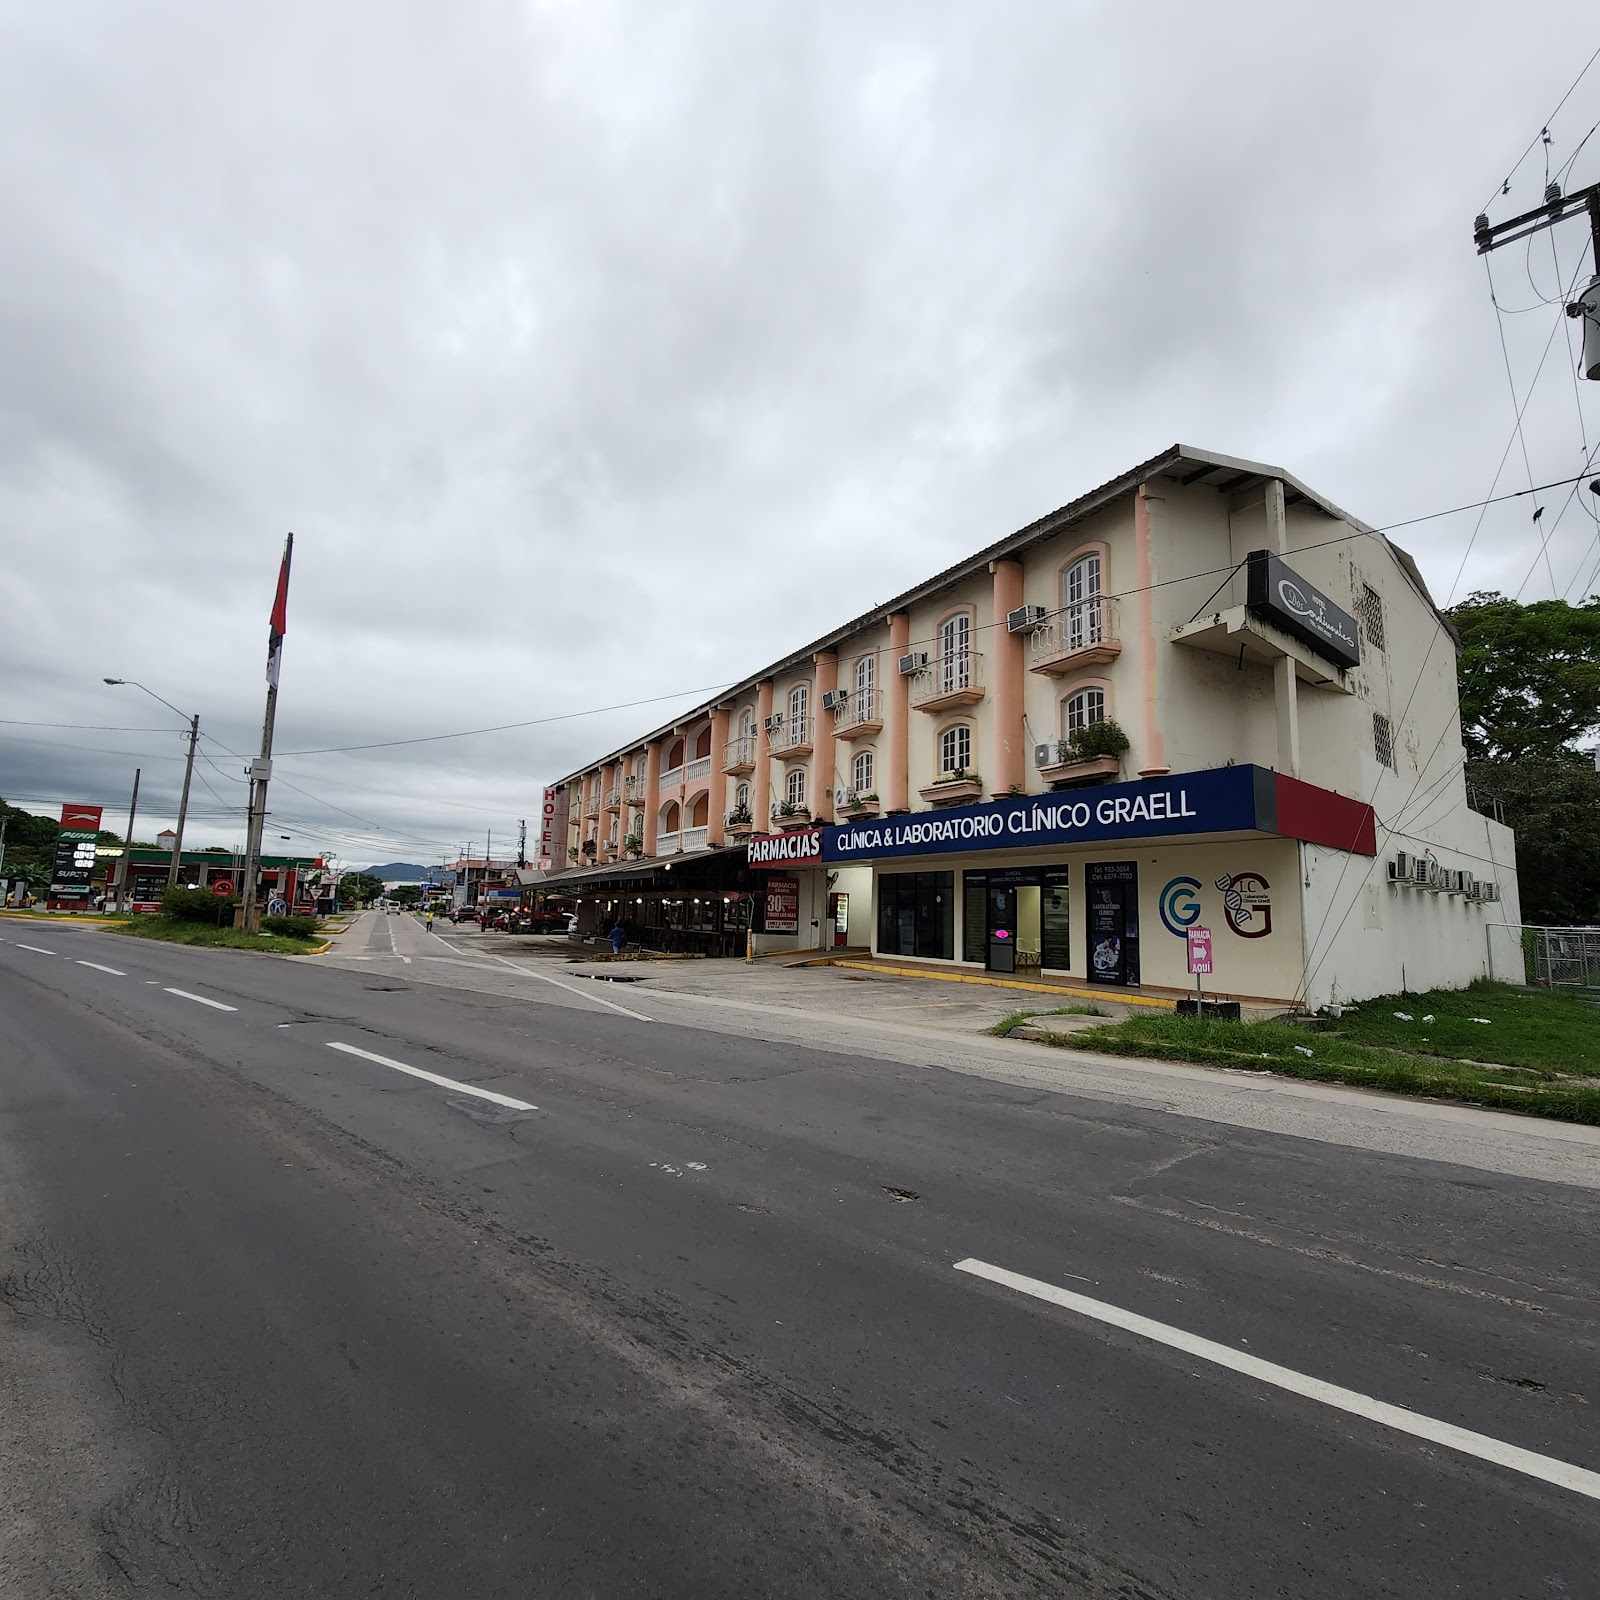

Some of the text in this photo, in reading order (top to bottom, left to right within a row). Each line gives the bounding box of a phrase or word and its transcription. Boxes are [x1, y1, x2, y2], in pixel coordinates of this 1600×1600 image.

[1288, 590, 1304, 610] Dos
[1312, 594, 1327, 611] HOTEL
[542, 790, 555, 856] HOTEL
[837, 790, 1197, 851] CLÍNICA & LABORATORIO CLÍNICO GRAELL
[60, 831, 97, 840] PUMA
[747, 832, 820, 863] FARMACIAS
[767, 881, 797, 889] FARMACIA
[1240, 881, 1257, 893] LC
[1188, 930, 1211, 940] FARMACIA
[1192, 961, 1211, 973] AQUÍ
